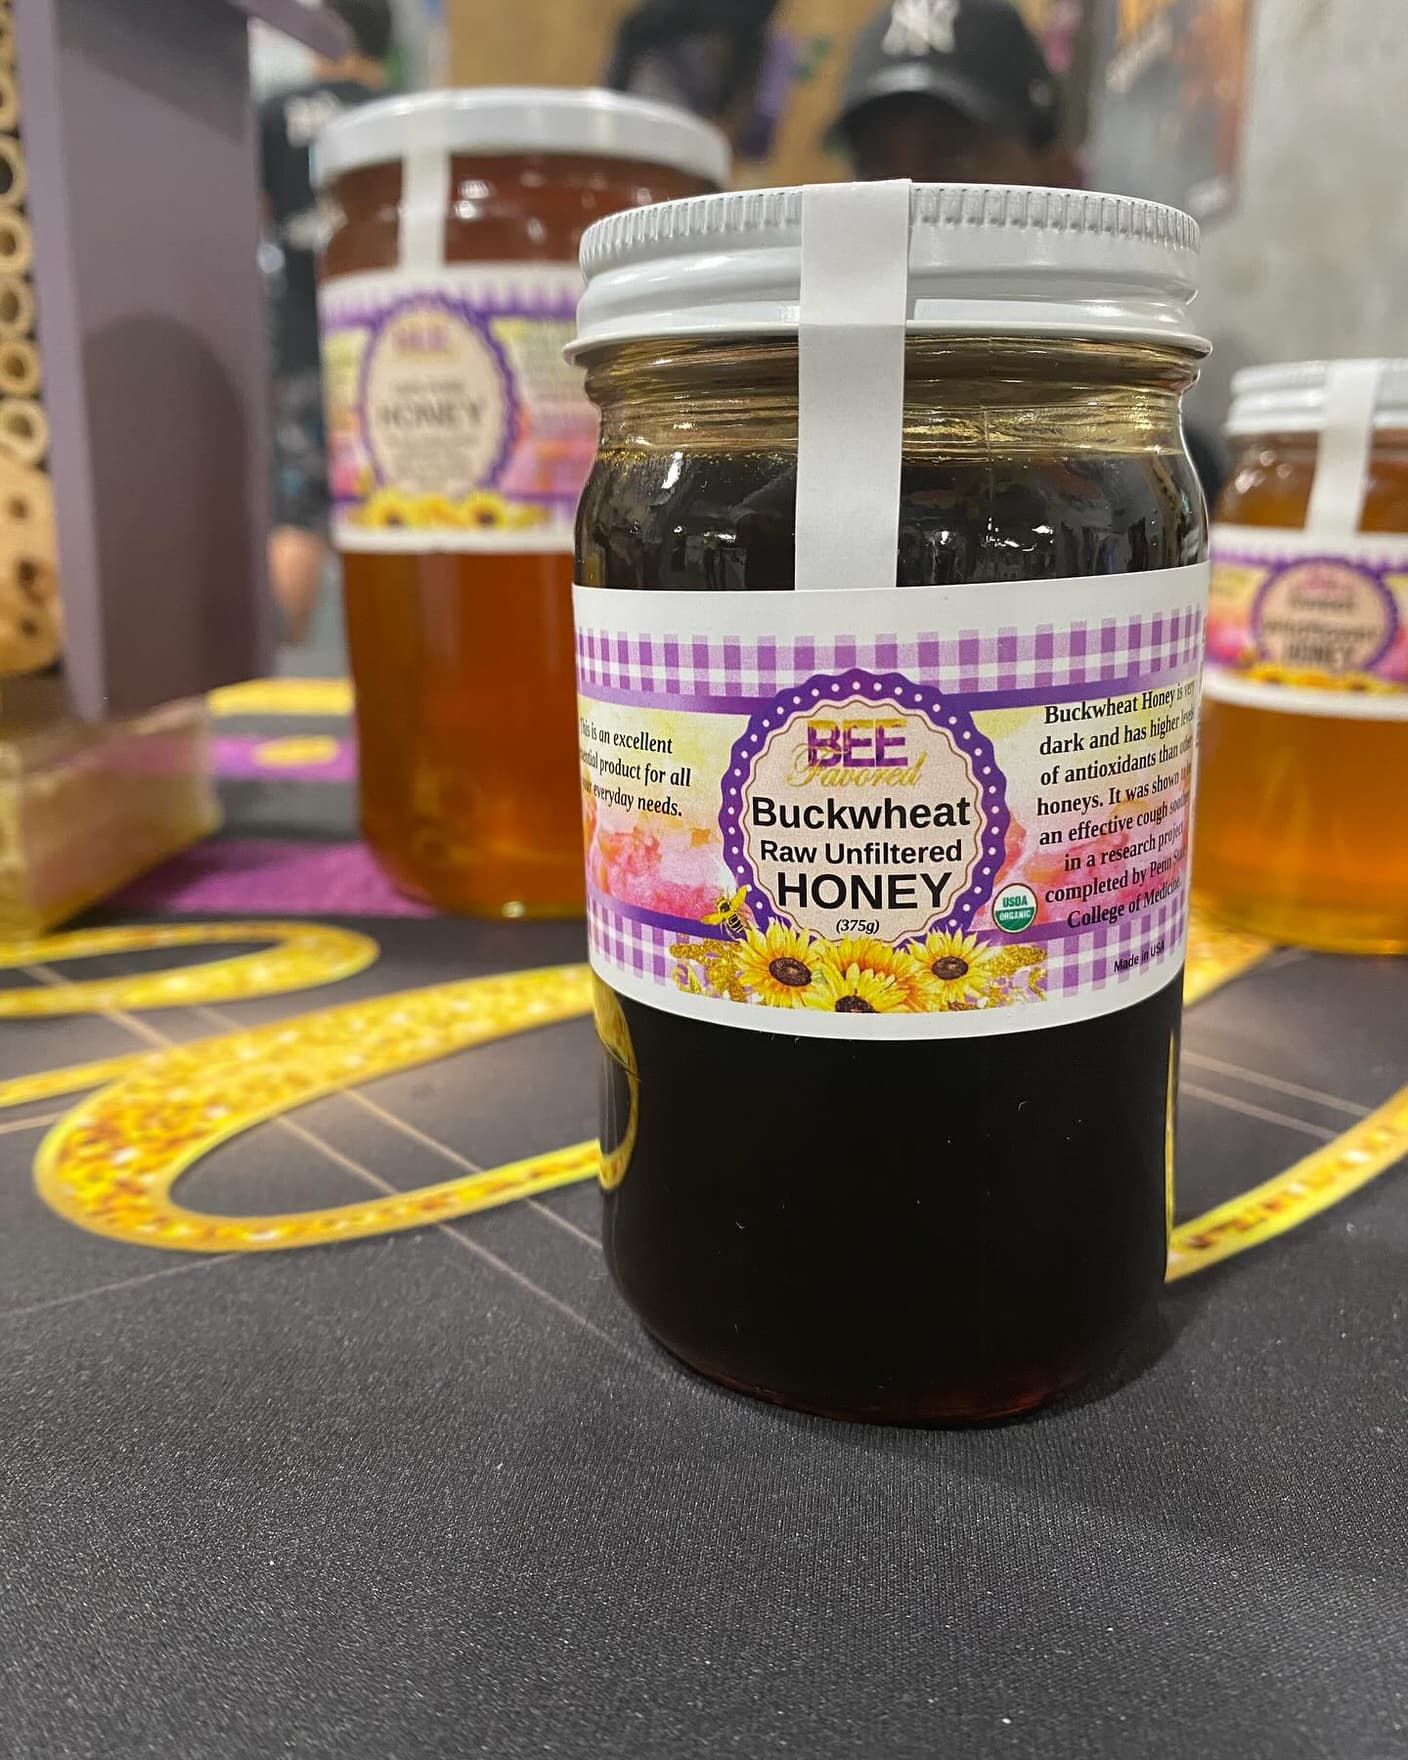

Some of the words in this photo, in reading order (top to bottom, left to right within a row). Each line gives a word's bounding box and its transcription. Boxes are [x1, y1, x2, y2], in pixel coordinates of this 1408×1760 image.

[1043, 697, 1138, 725] Buckwheat
[1141, 690, 1175, 709] Honey
[1176, 682, 1184, 701] is
[591, 722, 598, 741] is
[598, 729, 610, 745] an
[613, 731, 673, 755] excellent
[807, 718, 909, 768] BEE
[1039, 732, 1085, 755] dark
[1089, 726, 1119, 749] and
[1124, 725, 1147, 744] has
[1150, 714, 1180, 740] higher
[599, 758, 641, 779] product
[644, 763, 667, 787] for
[670, 767, 692, 787] all
[785, 743, 928, 788] Favored
[1040, 765, 1061, 786] of
[1064, 751, 1157, 783] antioxidants
[1159, 744, 1179, 763] than
[593, 784, 635, 813] everyday
[637, 796, 683, 817] needs.
[752, 796, 971, 829] Buckwheat
[1037, 793, 1104, 817] honeys.
[1108, 787, 1122, 806] It
[1126, 780, 1149, 801] was
[1152, 774, 1179, 794] shown
[1039, 830, 1062, 846] an
[1068, 815, 1133, 842] effective
[1136, 801, 1168, 824] cough
[760, 839, 817, 863] Raw
[825, 838, 963, 865] Unfiltered
[1064, 854, 1081, 872] in
[1086, 857, 1096, 867] a
[1101, 834, 1156, 864] research
[1158, 822, 1183, 852] project
[777, 871, 953, 910] HONEY
[1045, 869, 1128, 903] completed
[1132, 868, 1148, 887] by
[1150, 856, 1172, 878] Penn
[999, 909, 1032, 921] ORGANIC
[1002, 895, 1029, 908] USDA
[1067, 904, 1125, 929] College
[1128, 896, 1141, 913] of
[835, 919, 881, 934] (375g)
[1113, 956, 1139, 972] Made
[1140, 951, 1150, 962] in
[1150, 942, 1165, 957] USA
